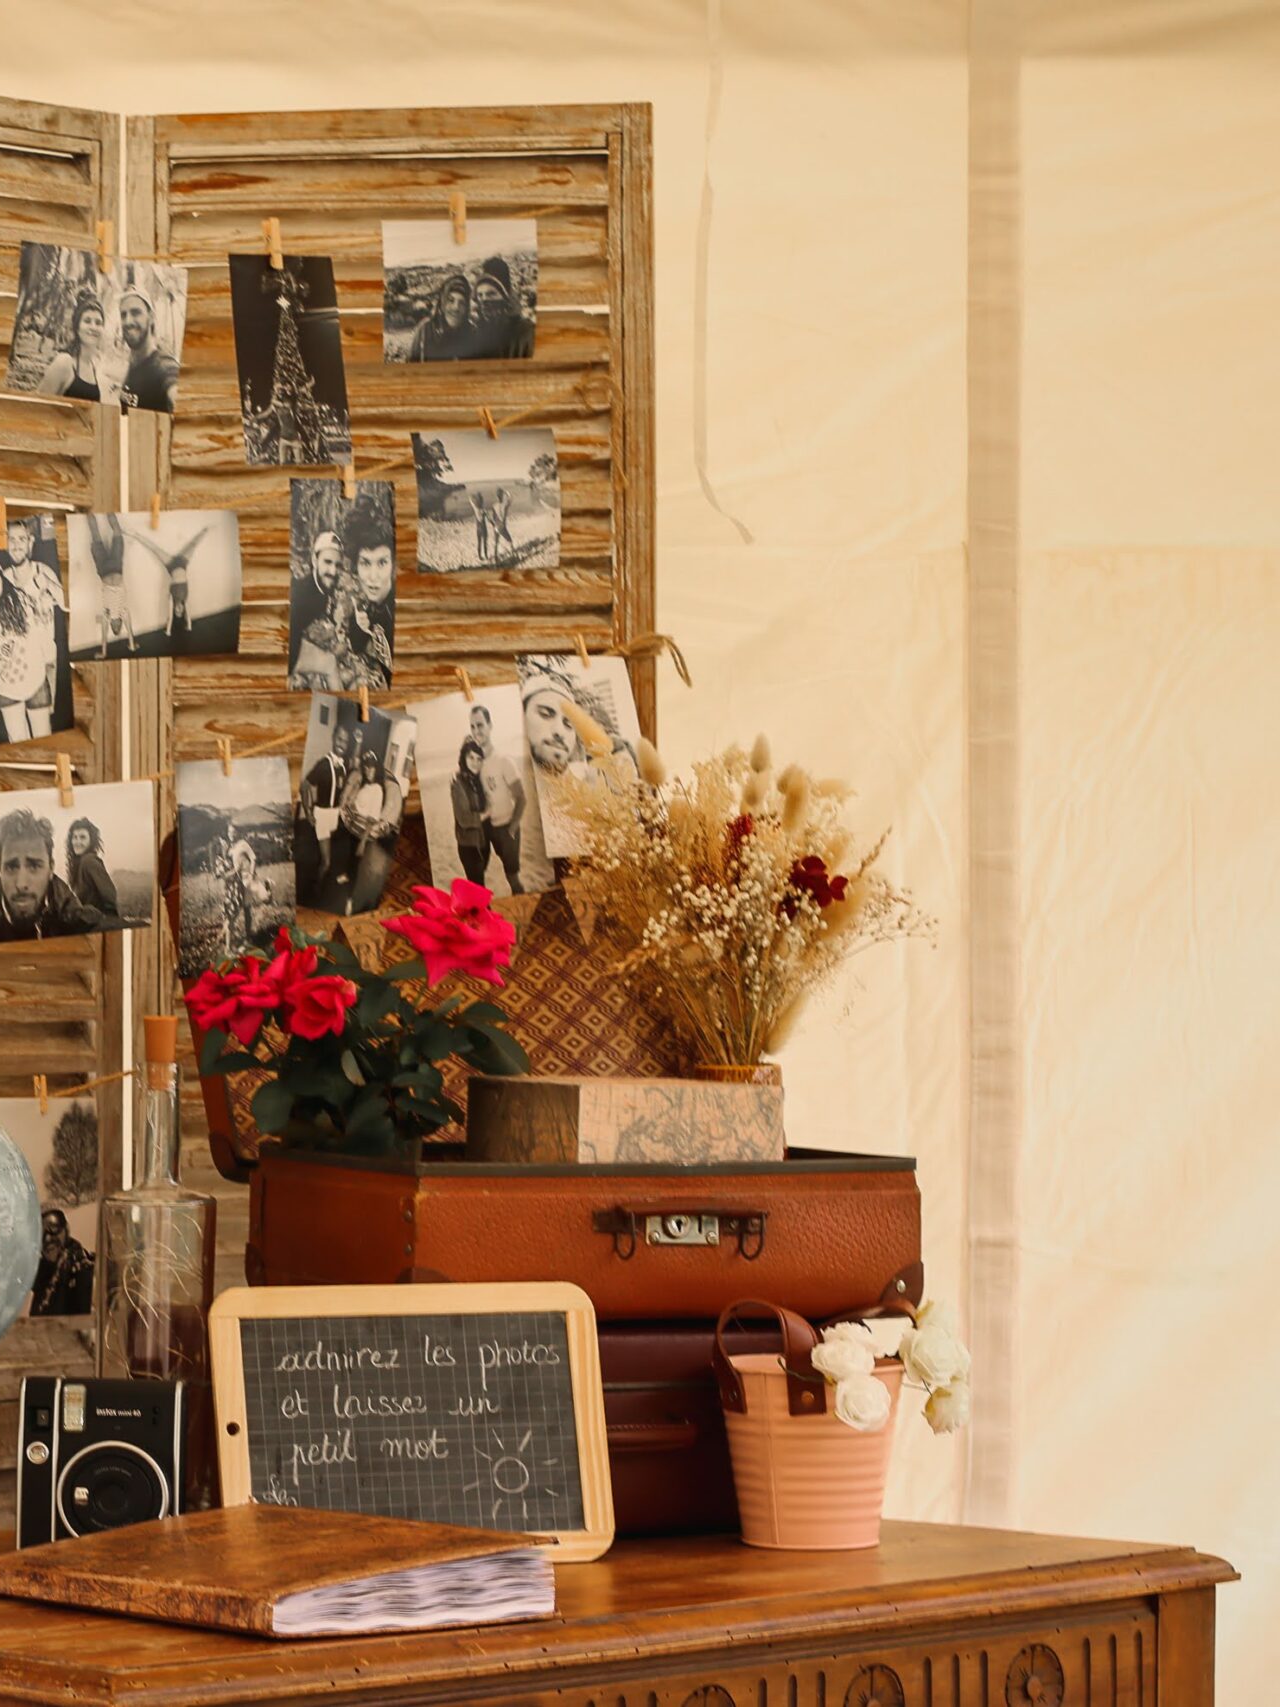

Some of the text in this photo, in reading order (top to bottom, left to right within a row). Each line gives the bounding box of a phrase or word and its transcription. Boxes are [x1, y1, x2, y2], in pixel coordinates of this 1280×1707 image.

[274, 1334, 560, 1391] admirez les photos
[281, 1383, 500, 1419] et laissez un
[291, 1428, 449, 1487] petit mot
